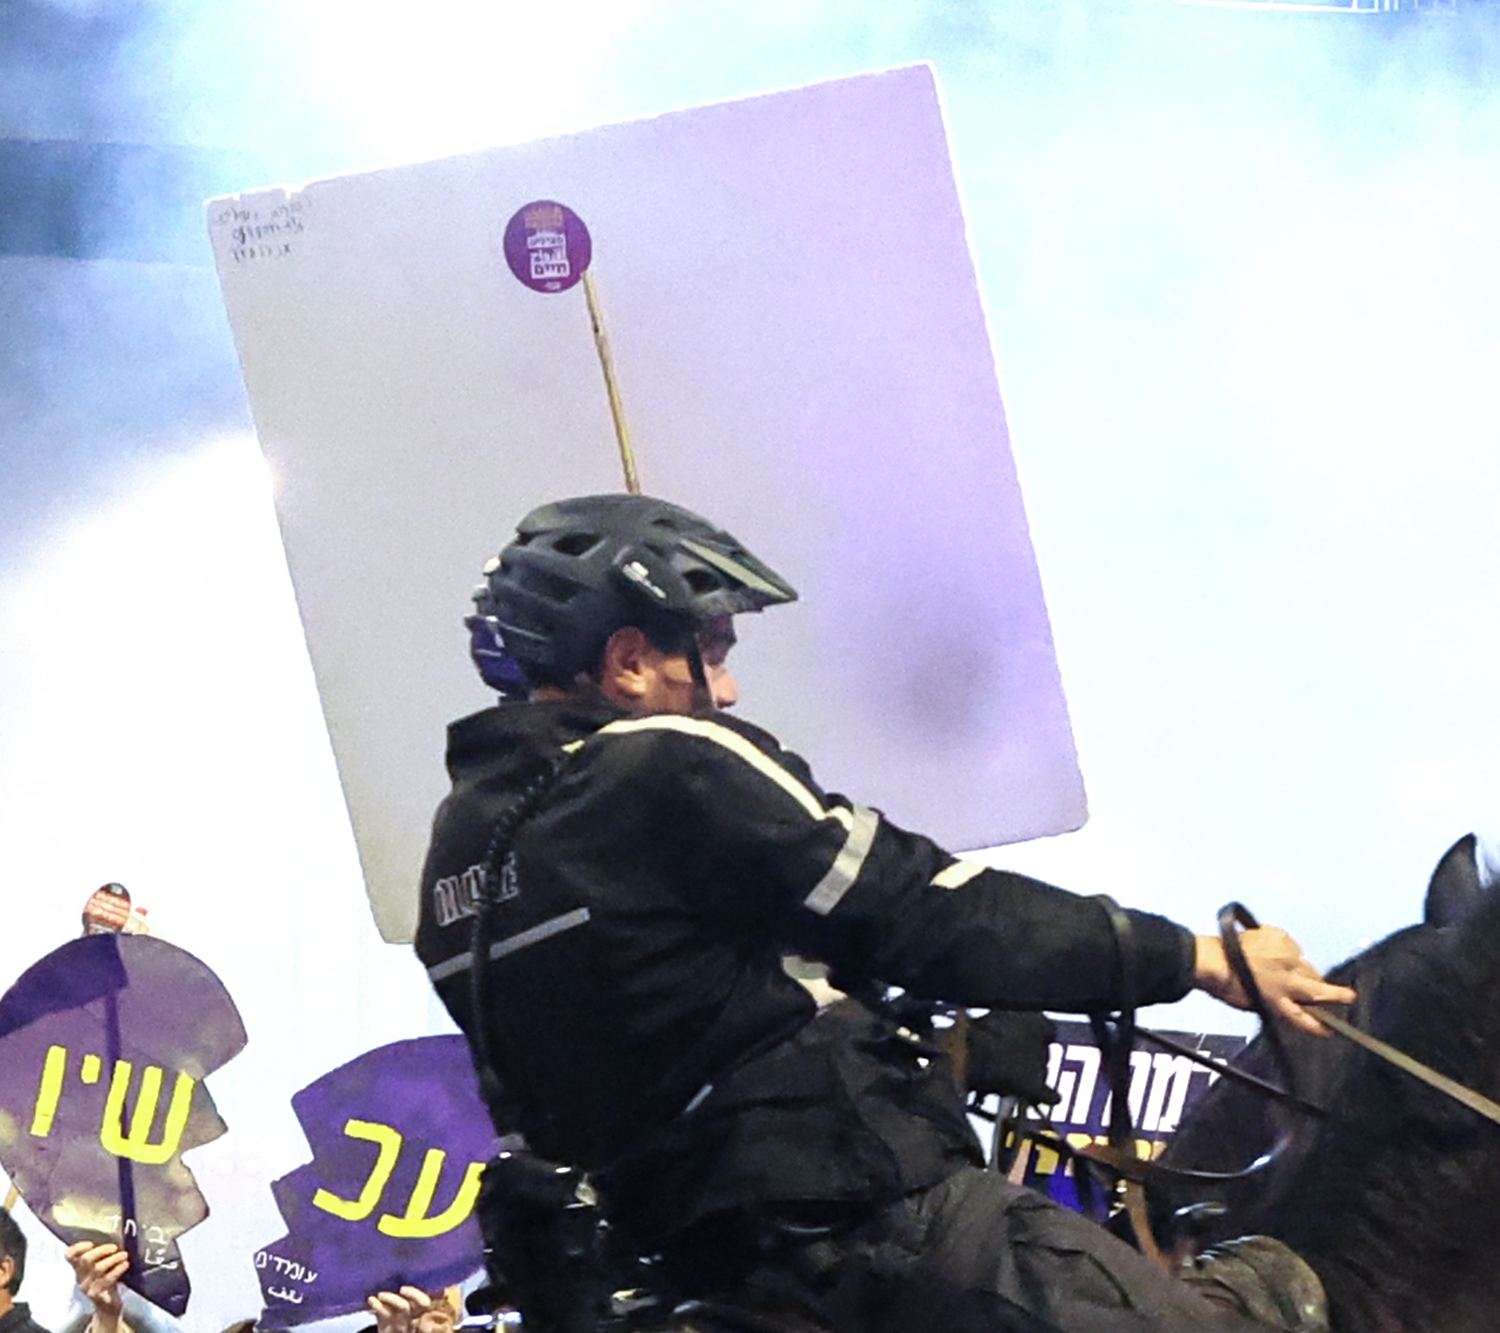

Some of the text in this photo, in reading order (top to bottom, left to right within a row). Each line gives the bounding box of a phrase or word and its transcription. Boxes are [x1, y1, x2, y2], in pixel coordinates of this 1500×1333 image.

[30, 1045, 195, 1165] שיו
[312, 1118, 487, 1238] עכ
[256, 1251, 318, 1283] עומדים
